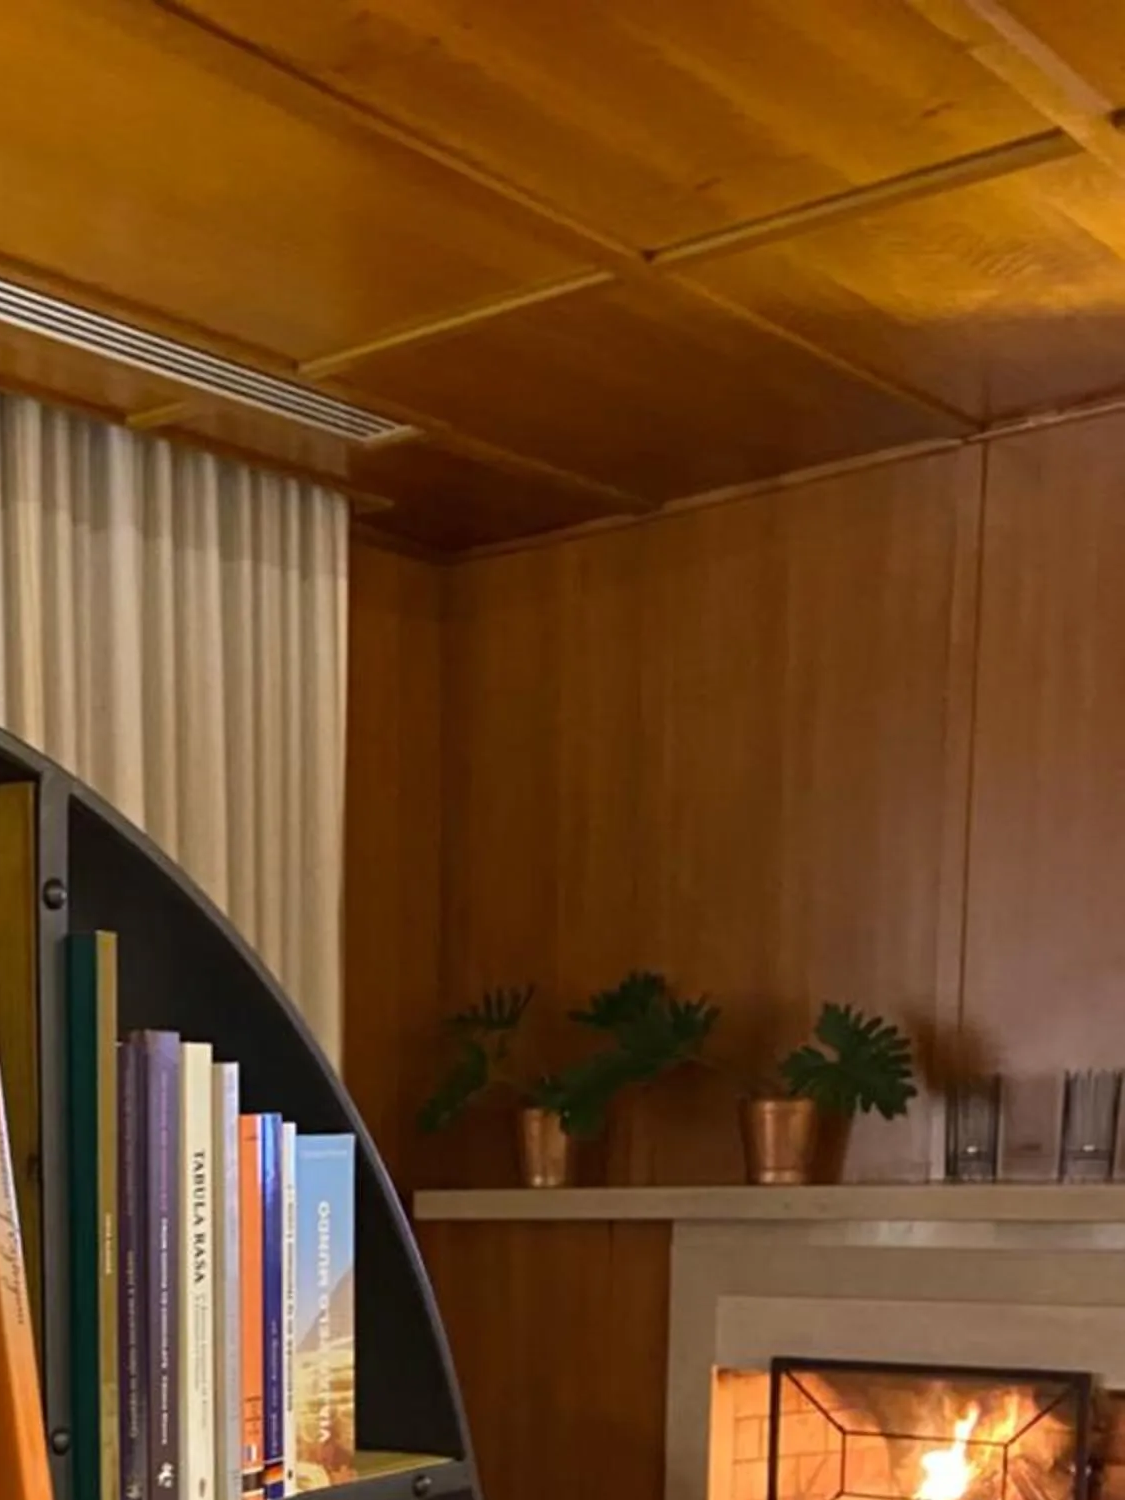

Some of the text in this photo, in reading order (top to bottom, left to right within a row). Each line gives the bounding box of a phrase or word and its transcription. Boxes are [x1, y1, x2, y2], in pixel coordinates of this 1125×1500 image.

[191, 1150, 207, 1226] TABULA
[192, 1231, 207, 1284] RASA
[314, 1200, 332, 1287] MUNDO
